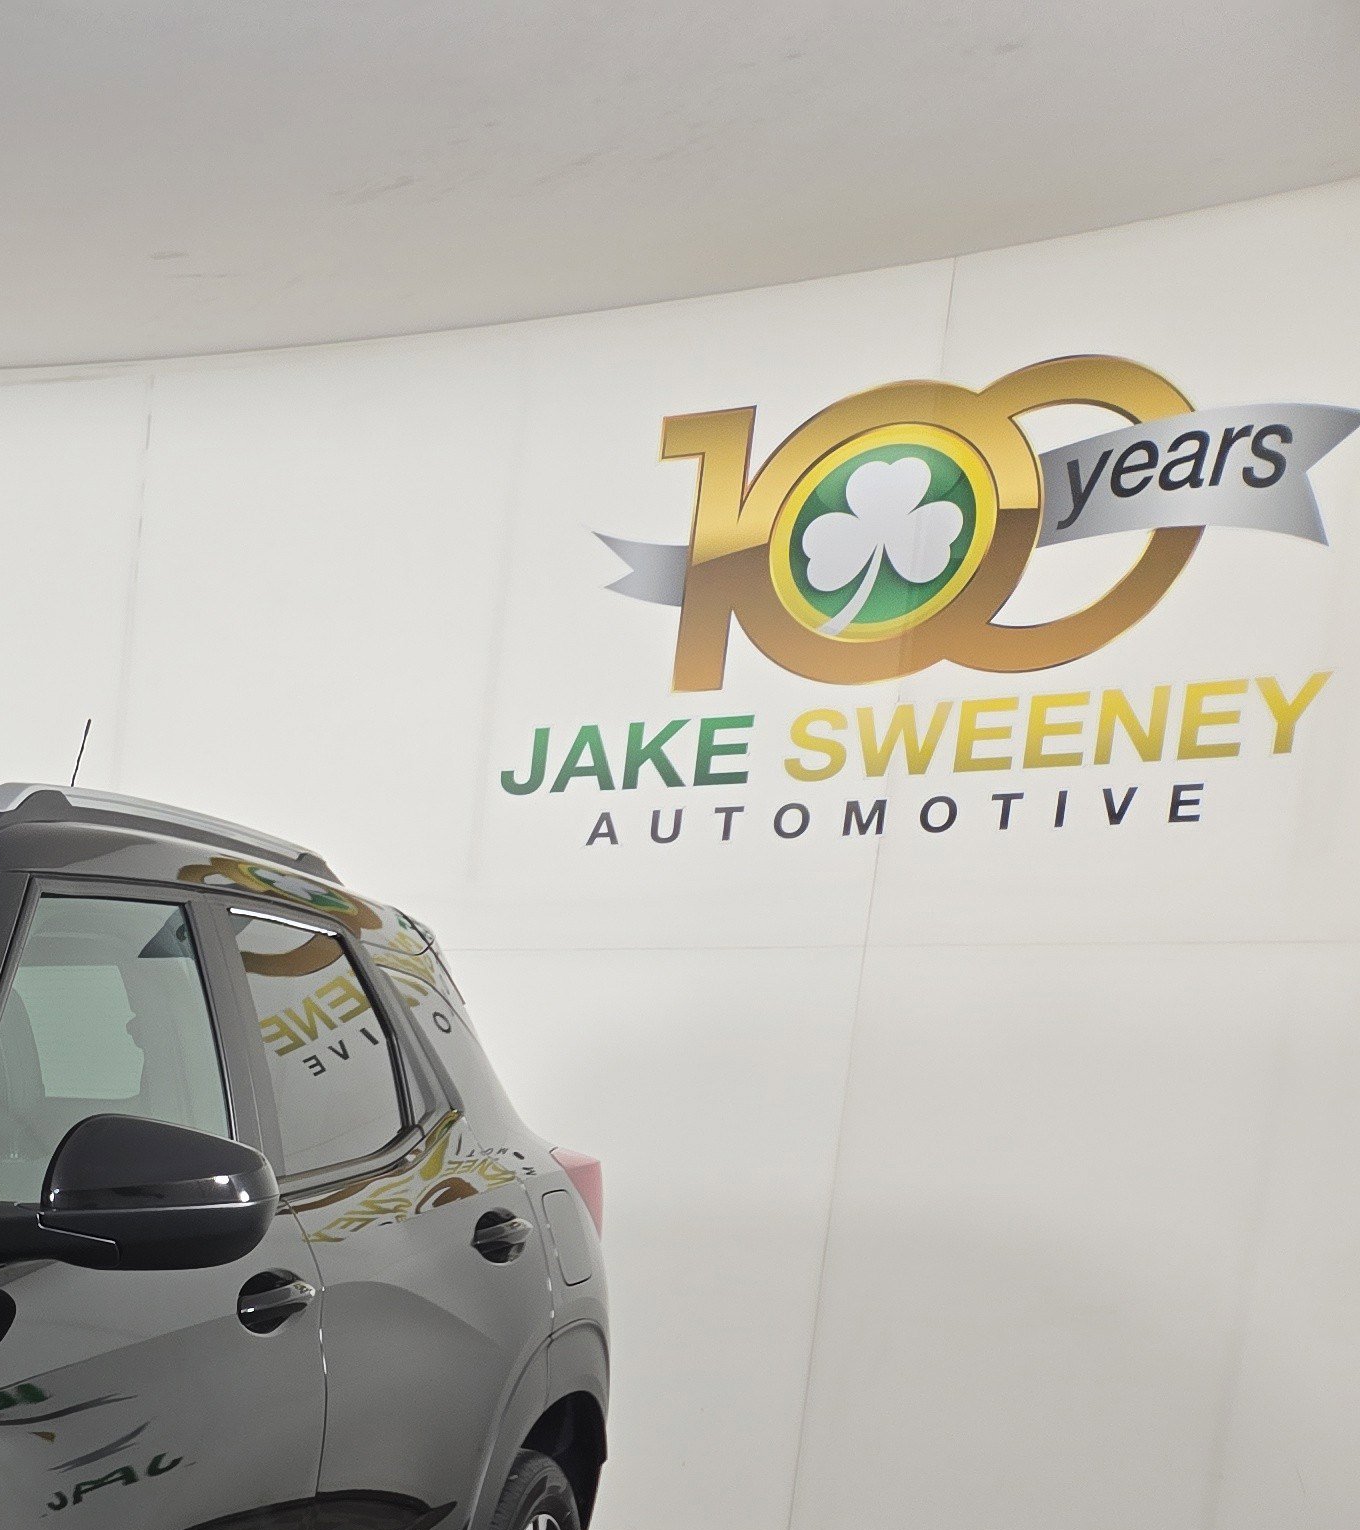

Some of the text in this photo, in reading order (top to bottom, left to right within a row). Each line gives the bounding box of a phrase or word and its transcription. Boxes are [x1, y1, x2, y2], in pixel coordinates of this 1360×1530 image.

[660, 353, 1294, 693] 100 years
[499, 670, 1334, 796] JAKE SWEENEY
[586, 783, 1205, 847] AUTOMOTIVE
